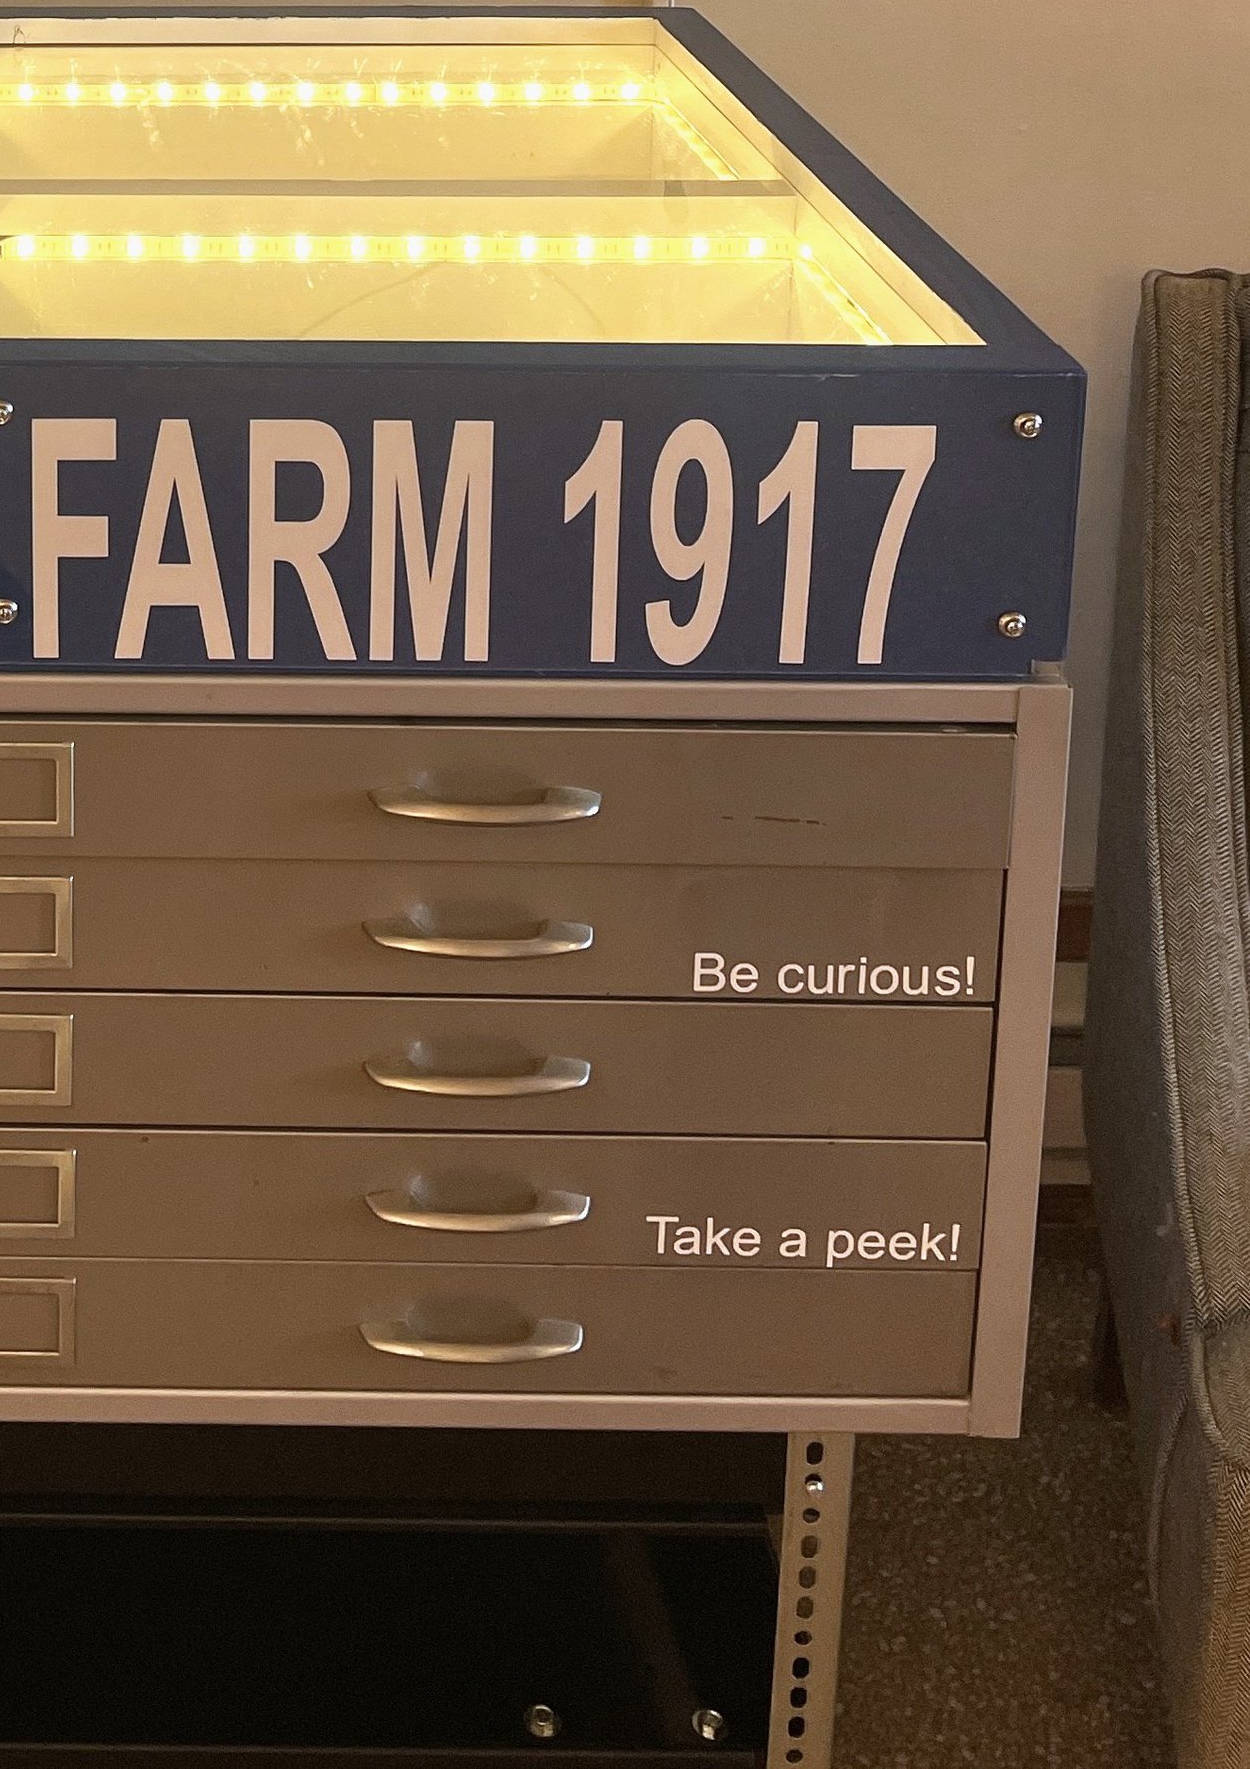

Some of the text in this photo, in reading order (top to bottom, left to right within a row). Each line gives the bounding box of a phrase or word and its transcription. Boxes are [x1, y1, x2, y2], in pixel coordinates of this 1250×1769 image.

[32, 419, 494, 661] FARM
[564, 419, 936, 665] 1917
[694, 953, 974, 995] Be curious!
[646, 1216, 960, 1267] Take a peek!
